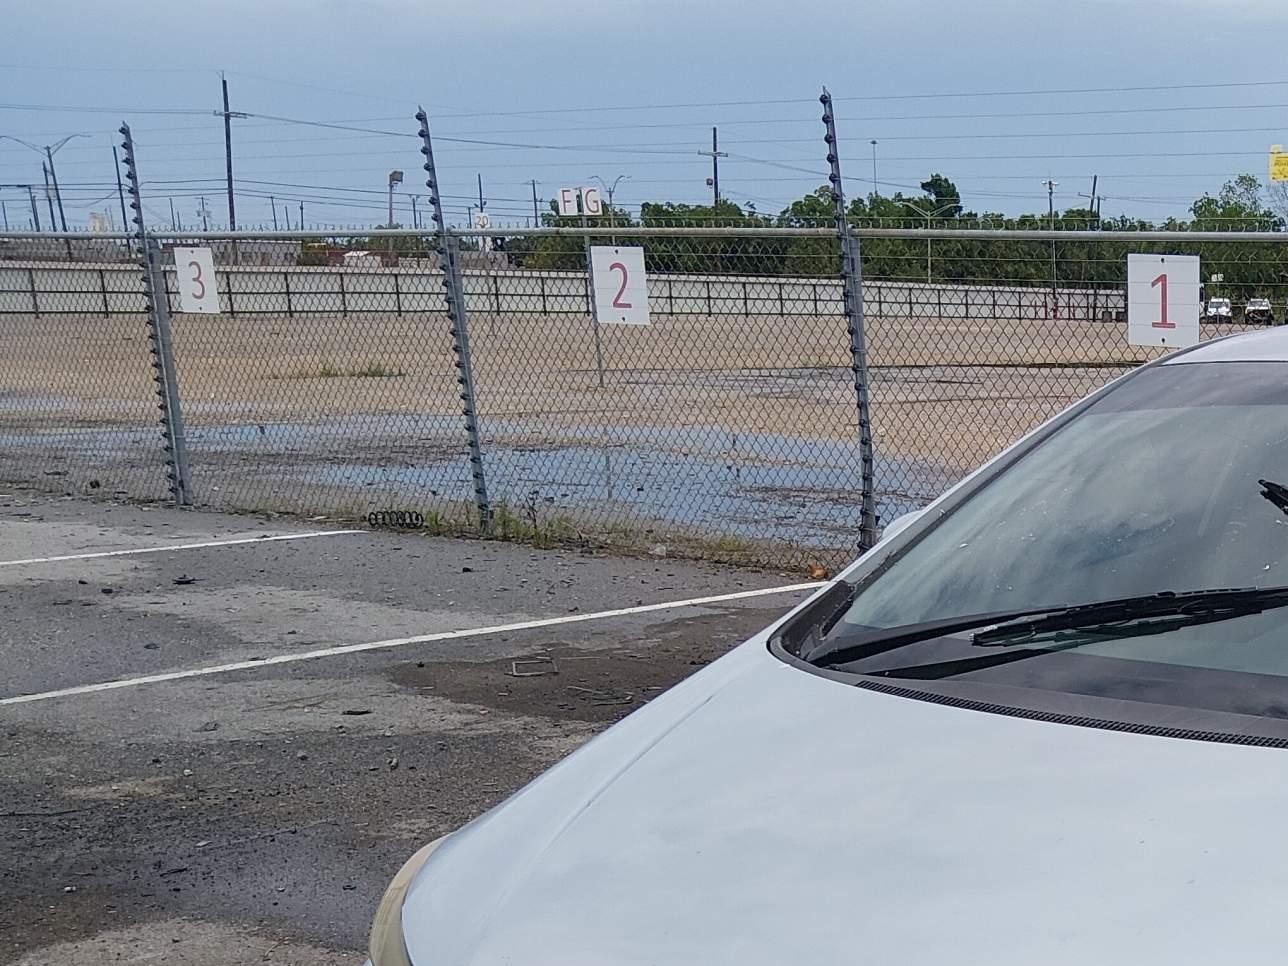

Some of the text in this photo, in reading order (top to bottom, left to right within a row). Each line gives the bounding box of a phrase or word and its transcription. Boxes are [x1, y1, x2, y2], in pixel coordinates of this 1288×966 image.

[561, 189, 571, 214] F
[584, 189, 600, 214] G
[188, 261, 205, 300] 3
[609, 262, 632, 308] 2
[1151, 273, 1176, 329] 1
